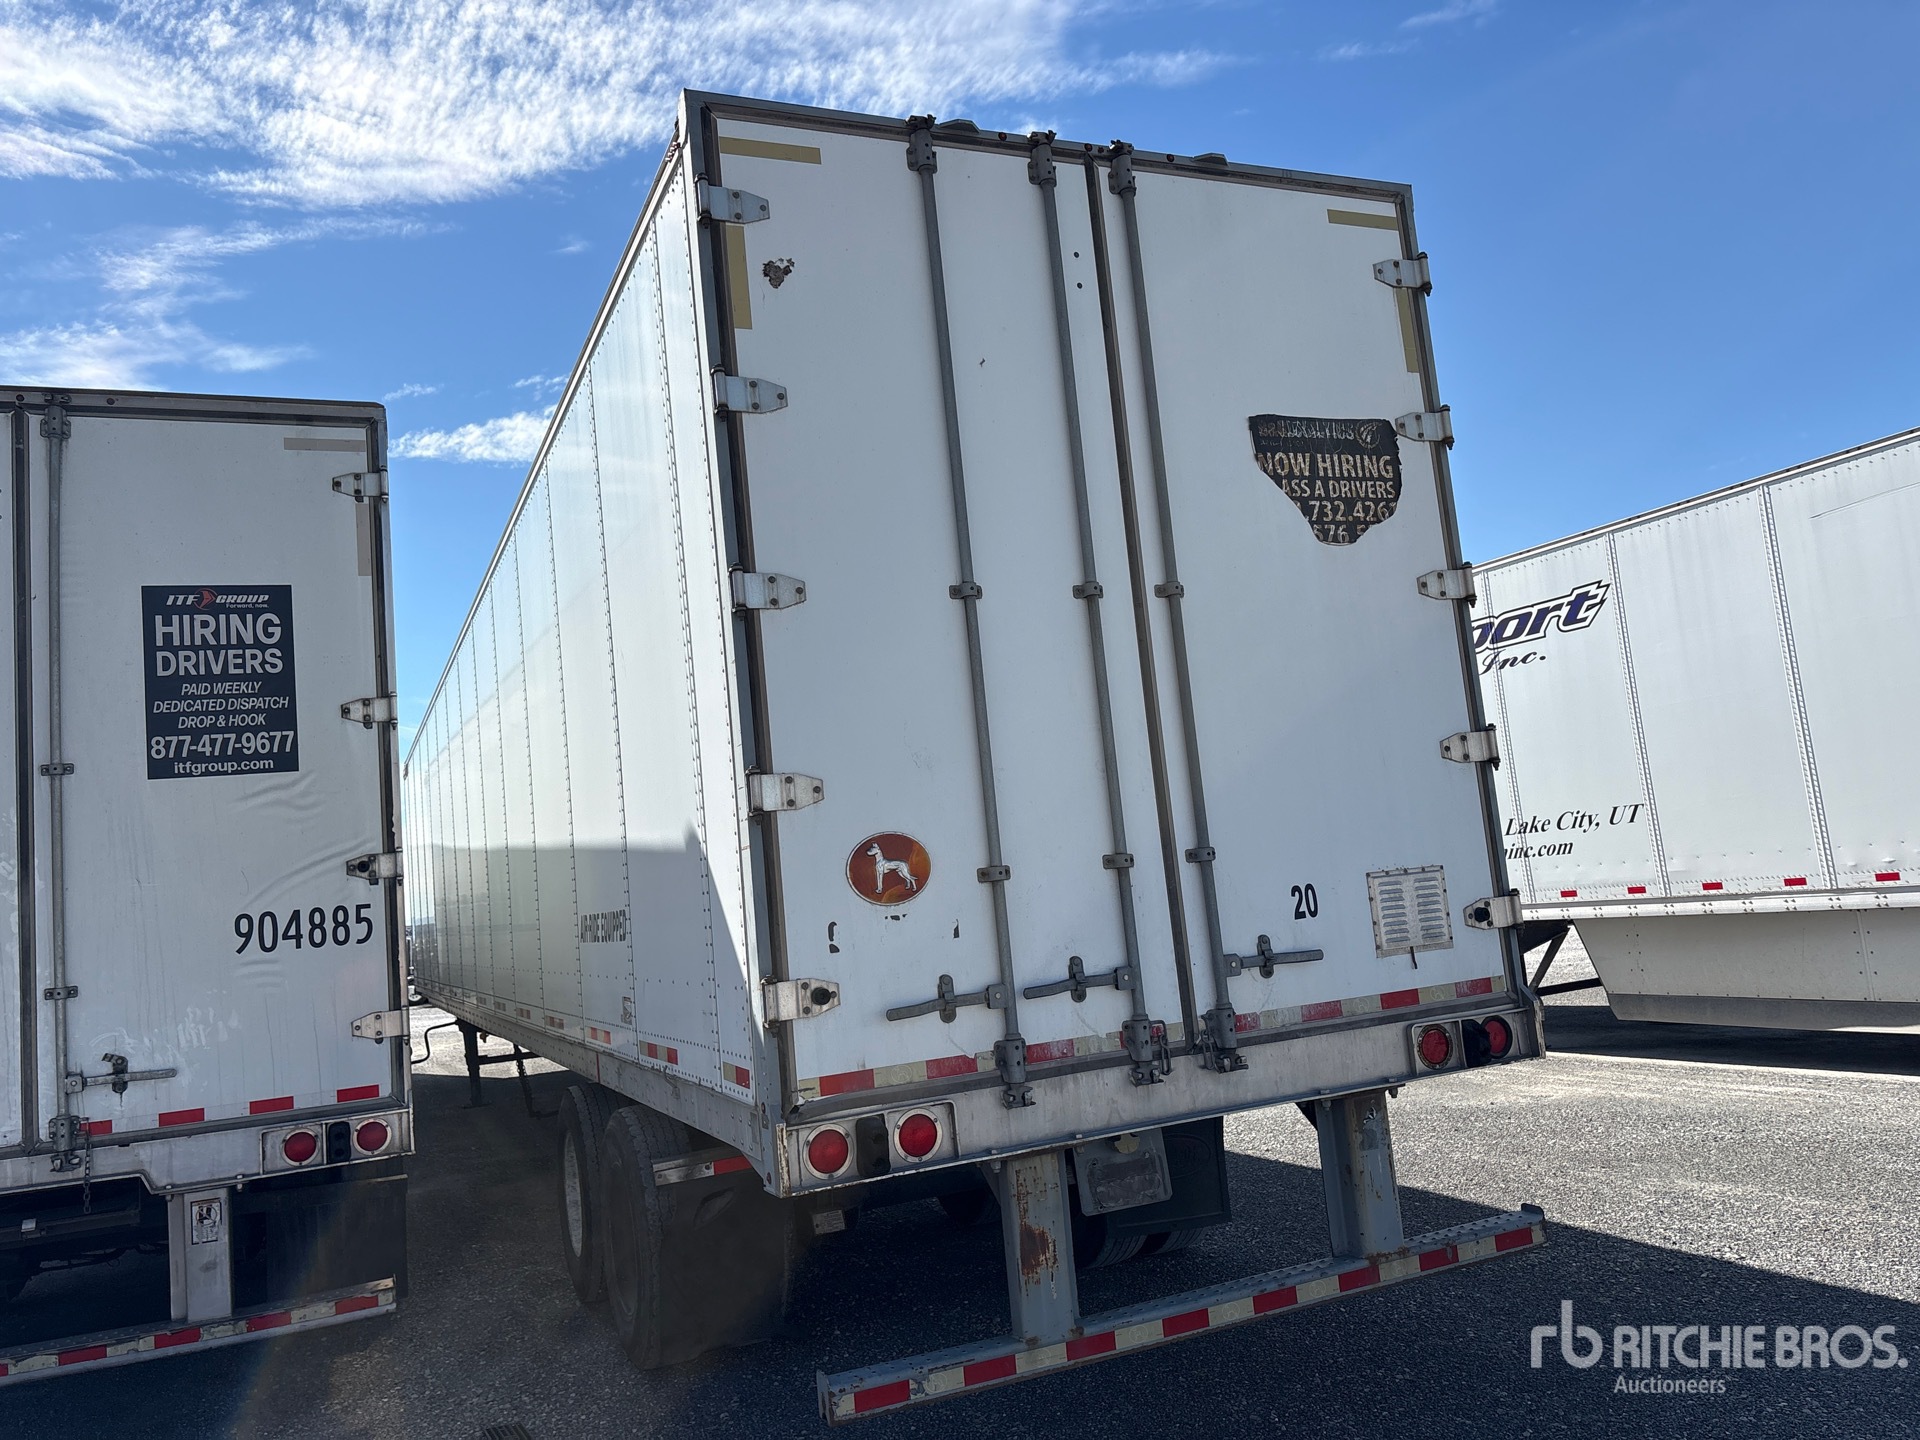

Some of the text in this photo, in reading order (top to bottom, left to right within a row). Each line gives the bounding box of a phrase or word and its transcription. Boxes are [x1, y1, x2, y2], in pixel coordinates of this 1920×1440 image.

[1257, 452, 1394, 479] NOW HIRING
[1314, 480, 1326, 498] A
[1328, 480, 1396, 499] DRIVERS
[166, 594, 270, 606] ITF GROUP
[154, 612, 282, 646] HIRING
[156, 648, 284, 676] DRIVERS
[1479, 648, 1547, 676] Inc.
[181, 681, 262, 696] PAID WEEKLY
[153, 696, 289, 713] DEDICATED DISPATCH
[178, 713, 266, 729] DROP & HOOK
[150, 730, 295, 759] 877-477-9677
[174, 759, 274, 776] itfgroup.com
[1504, 803, 1645, 836] Lake City, UT
[1290, 883, 1319, 920] 20
[234, 903, 374, 955] 904885
[601, 909, 627, 943] EQUIPPED
